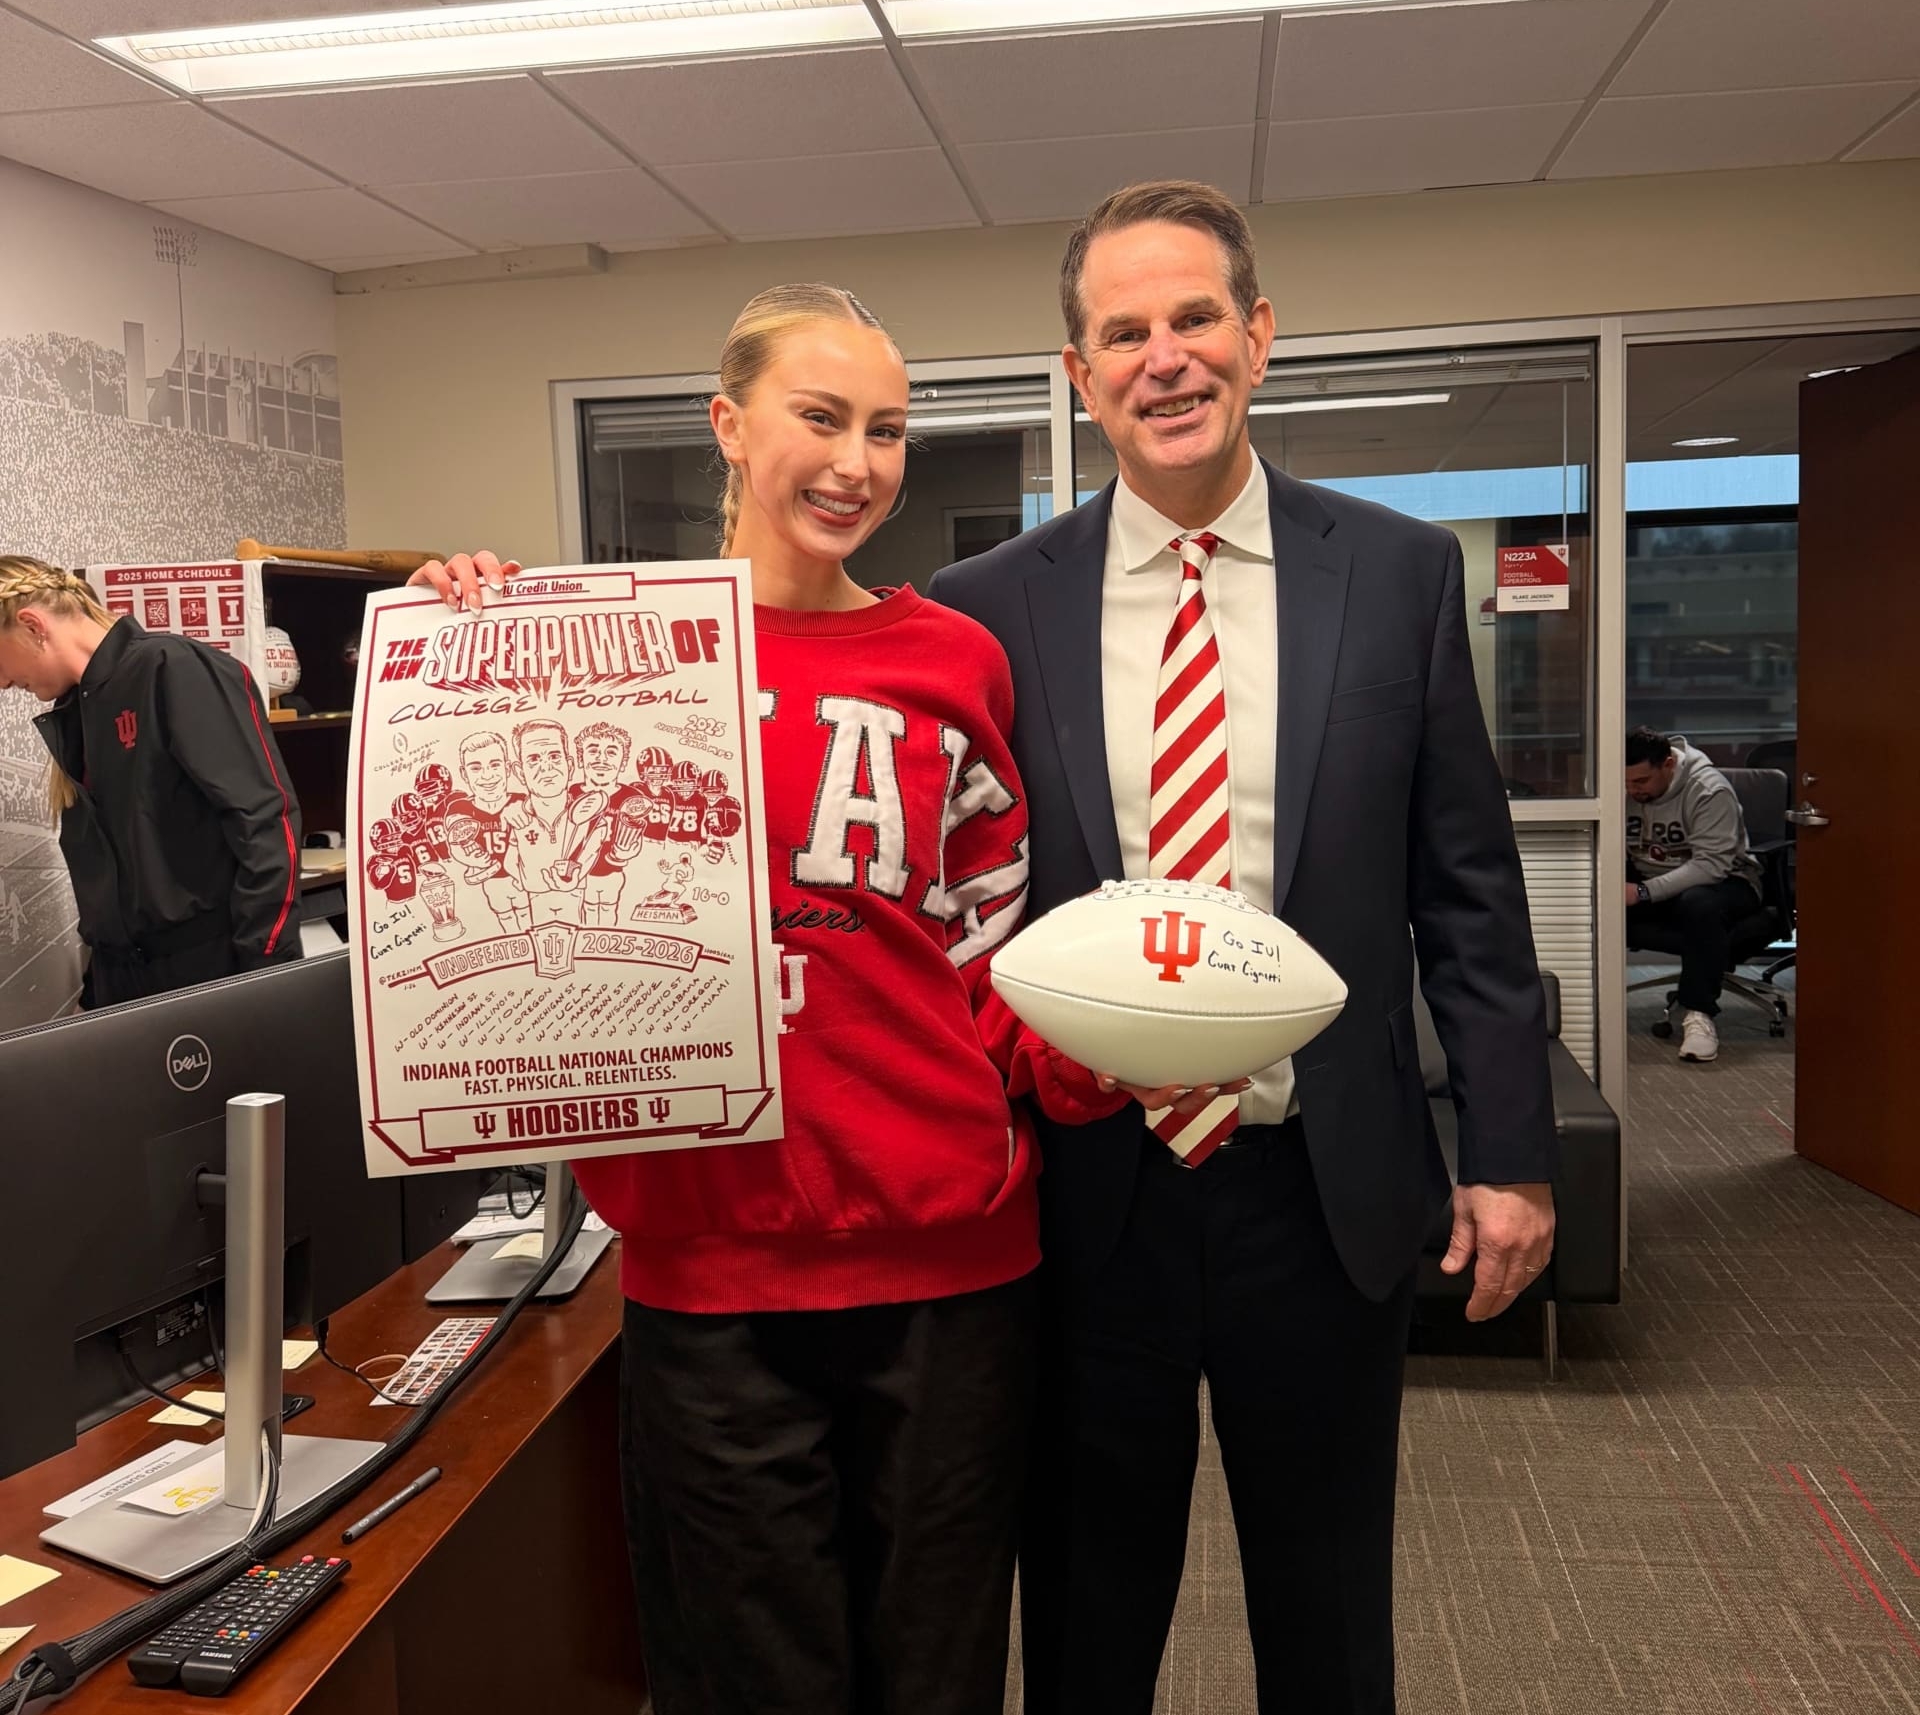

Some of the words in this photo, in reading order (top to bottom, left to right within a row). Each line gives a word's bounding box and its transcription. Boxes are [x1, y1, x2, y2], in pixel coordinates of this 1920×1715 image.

[1504, 552, 1537, 562] N223A
[117, 572, 142, 582] 2025
[144, 570, 174, 580] HOME
[177, 568, 232, 578] SCHEDULE
[516, 582, 548, 594] Credit
[551, 580, 582, 592] Union
[1504, 571, 1535, 579] FOOTBALL
[386, 637, 428, 659] THE
[423, 612, 676, 686] SUPERPOWER
[670, 618, 720, 664] OF
[379, 657, 426, 683] NEW
[388, 695, 537, 725] COLLEGE
[557, 688, 708, 711] FOOTBALL
[654, 722, 708, 742] NATIONAL
[684, 714, 727, 738] 2025
[678, 738, 734, 760] CHAMPS
[648, 803, 672, 824] 65
[669, 810, 698, 832] 78
[428, 824, 447, 845] 13
[483, 831, 507, 854] 15
[415, 845, 430, 864] 6
[396, 864, 412, 884] 5
[692, 887, 730, 906] 16-0
[373, 921, 390, 934] Go
[390, 904, 416, 924] IU!
[636, 910, 680, 920] HEISMAN
[434, 938, 530, 980] UNDEFEATED
[582, 934, 694, 964] 2025-2026
[1222, 930, 1244, 950] Go
[1250, 940, 1281, 968] IU!
[499, 988, 534, 1023] IOWA
[514, 987, 553, 1026] OREGON
[532, 994, 565, 1029] MICHIGAN
[564, 983, 576, 995] ST
[556, 983, 592, 1021] UCLA
[570, 983, 608, 1023] MARYLAND
[589, 995, 612, 1020] PENN
[605, 980, 644, 1022] WISCONSIN
[625, 980, 663, 1020] PURDUE
[646, 990, 671, 1016] OHIO
[662, 978, 700, 1017] ALABAMA
[682, 975, 717, 1014] OREGON
[701, 979, 730, 1012] MIAMI
[410, 1024, 424, 1038] OLD
[424, 994, 458, 1025] DOMINION
[456, 1004, 486, 1031] INDIANA
[476, 990, 516, 1029] ILLINOIS
[172, 1048, 208, 1075] DELL
[402, 1060, 472, 1083] INDIANA
[475, 1054, 556, 1077] FOOTBALL
[558, 1048, 638, 1070] NATIONAL
[640, 1041, 734, 1064] CHAMPIONS
[464, 1080, 502, 1096] FAST.
[506, 1074, 582, 1093] PHYSICAL.
[585, 1066, 677, 1087] RELENTLESS.
[507, 1097, 640, 1138] HOOSIERS
[200, 1651, 232, 1659] SAMSUNG
